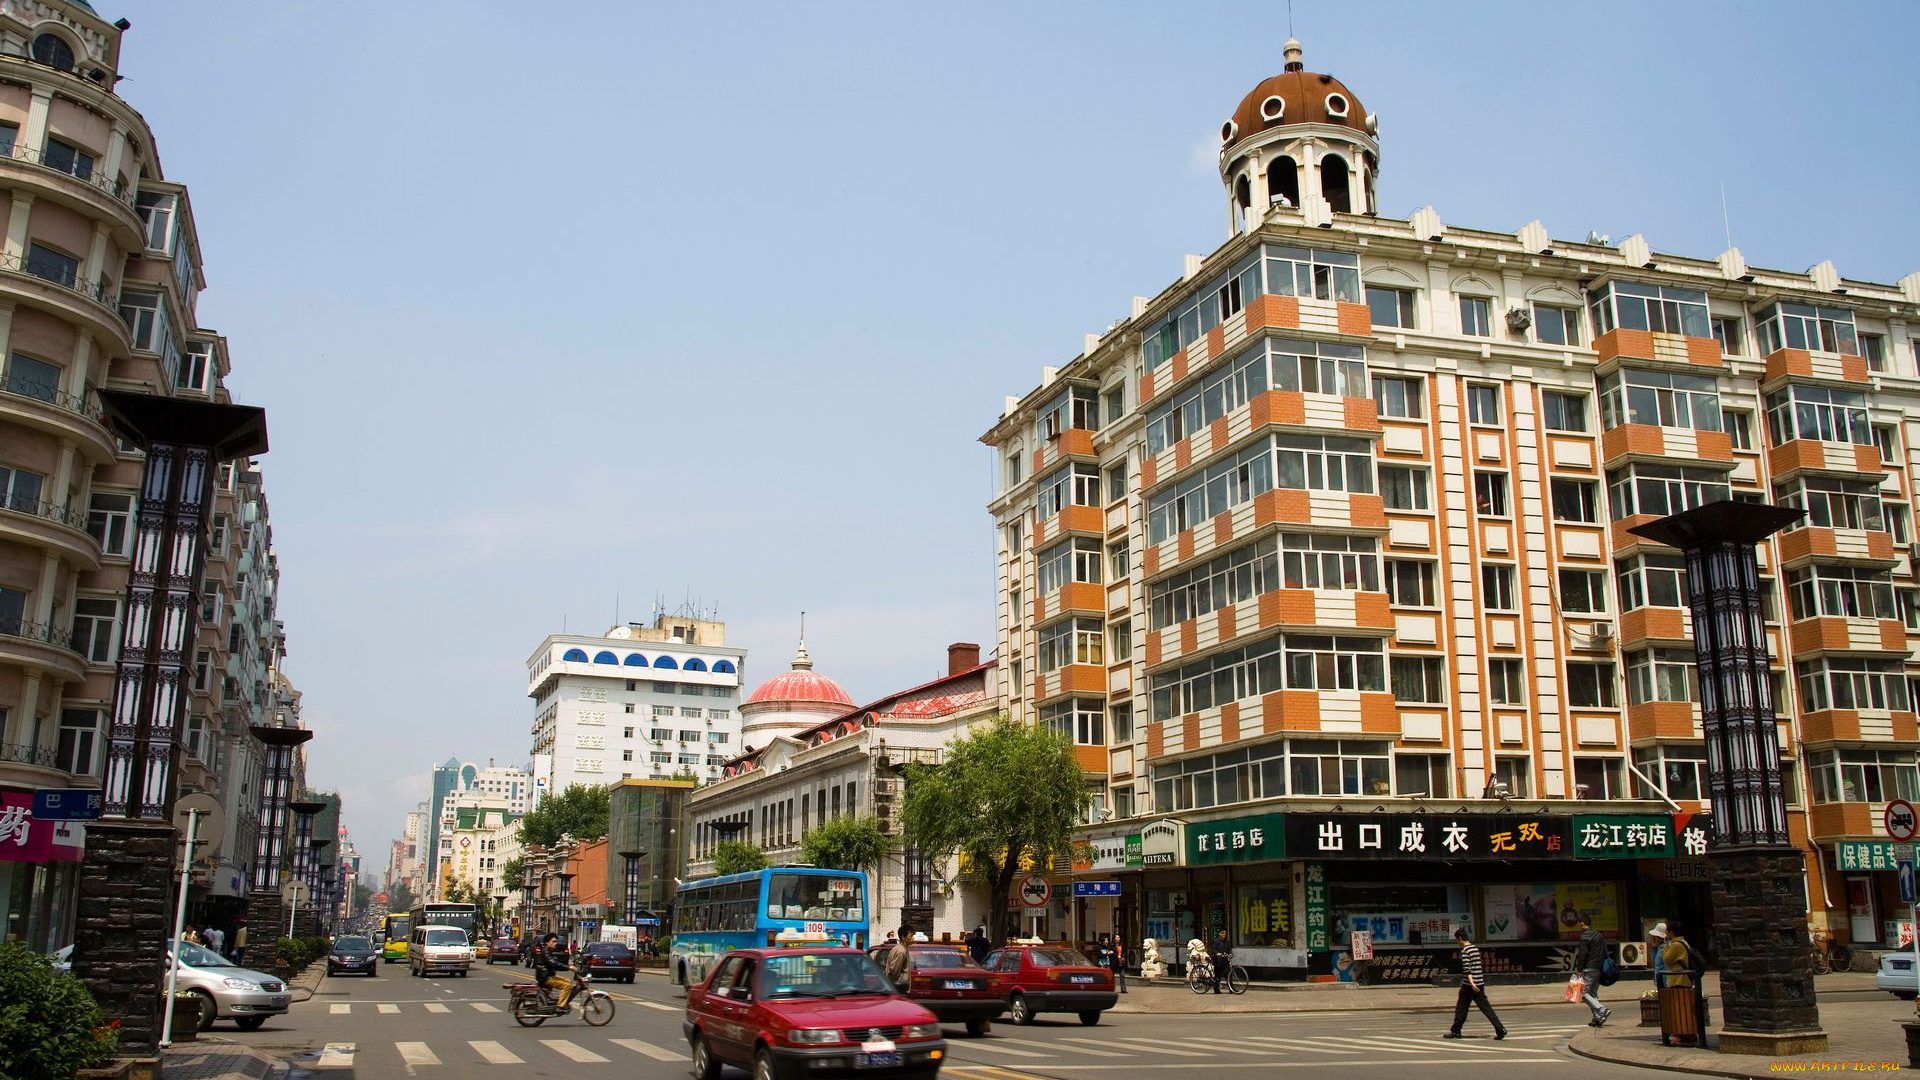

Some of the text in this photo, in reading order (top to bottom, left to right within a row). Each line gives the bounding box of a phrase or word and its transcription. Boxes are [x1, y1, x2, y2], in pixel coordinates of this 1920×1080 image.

[0, 806, 32, 847] 药
[1580, 823, 1666, 848] 龙江药店
[1684, 818, 1715, 855] 格
[1198, 827, 1264, 851] 龙江药店
[1318, 821, 1469, 854] 出口成衣
[1143, 855, 1171, 864] АПТЕКА
[1843, 844, 1920, 869] 保健品专
[834, 882, 849, 890] 109
[1079, 883, 1117, 892] 巴陵街
[1307, 865, 1325, 947] 龙江药店
[808, 923, 823, 933] 109
[1409, 918, 1450, 933] 正宗伟哥
[1367, 954, 1433, 967] 阶很多您辛苦了
[1563, 952, 1579, 971] SA
